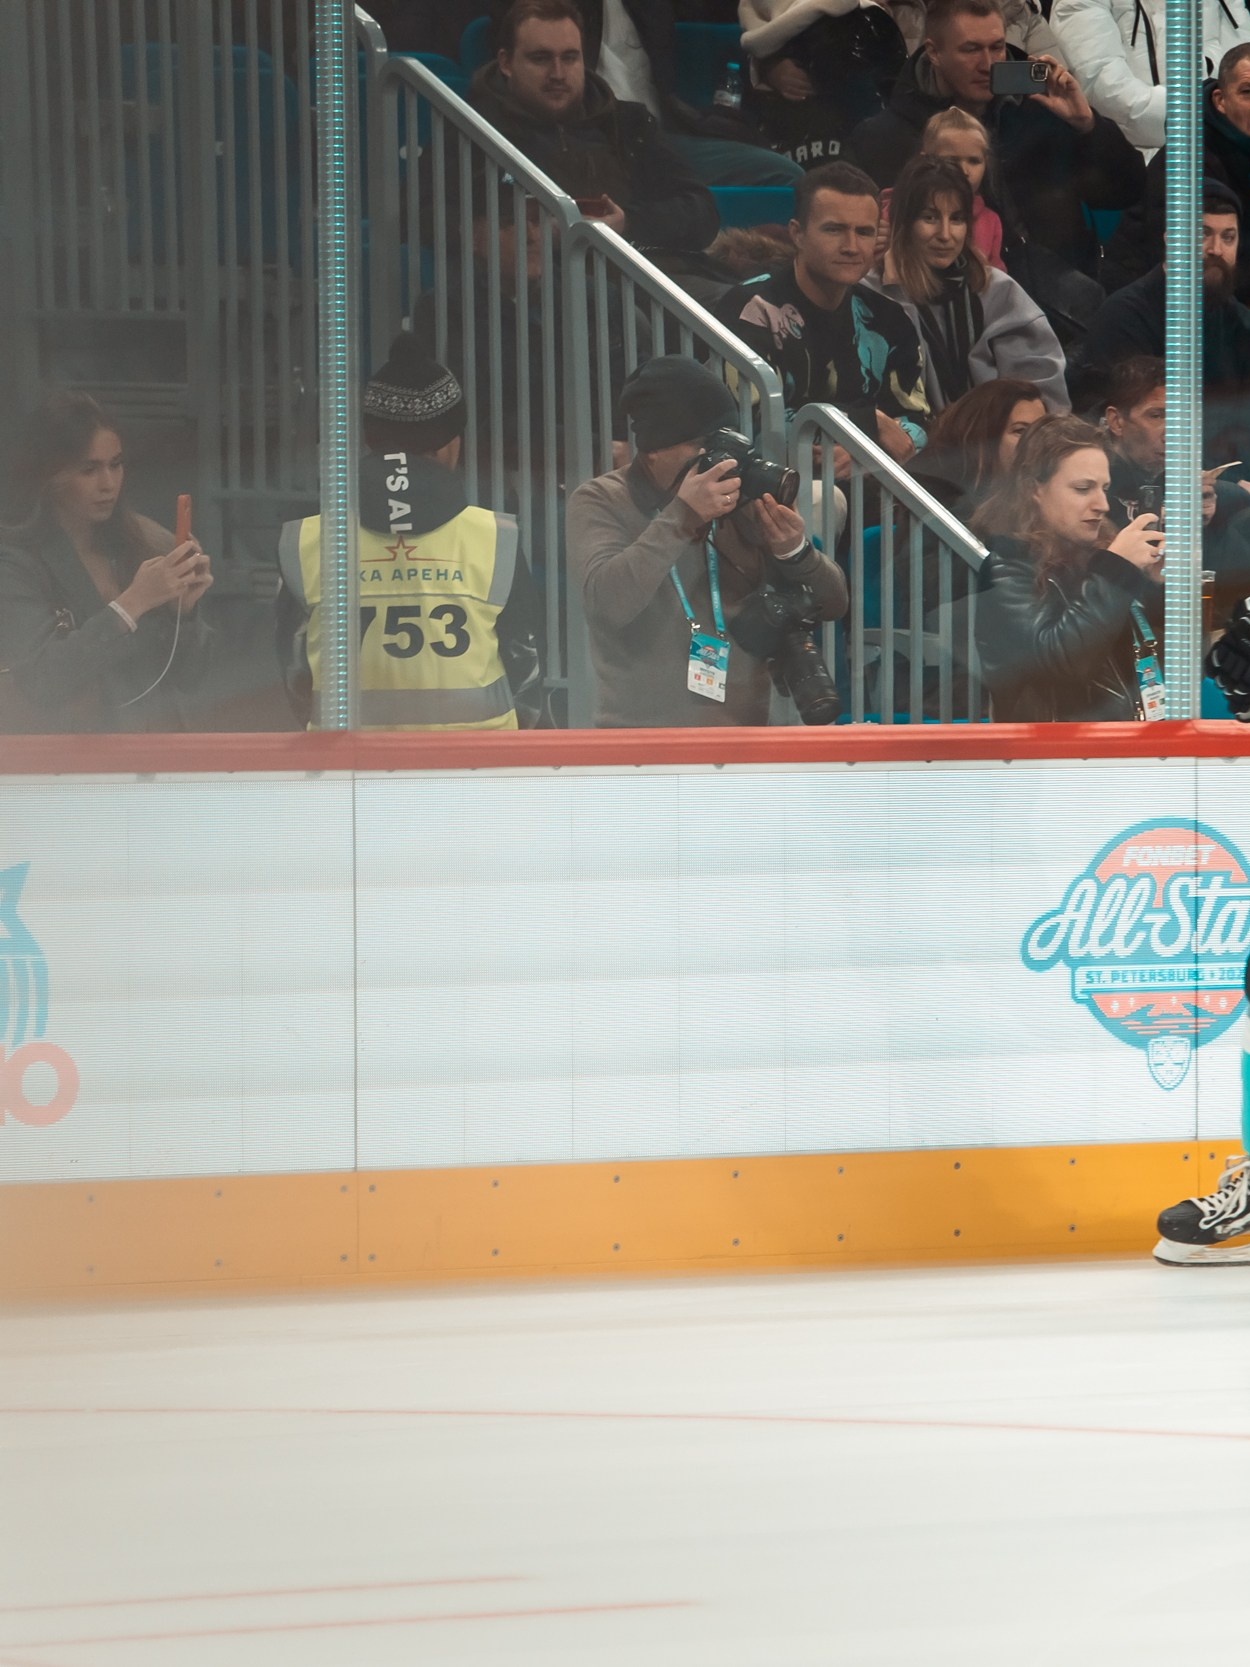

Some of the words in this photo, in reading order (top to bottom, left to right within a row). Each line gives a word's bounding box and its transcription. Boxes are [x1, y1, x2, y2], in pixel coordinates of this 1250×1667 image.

[391, 568, 464, 582] АРЕНА
[1122, 844, 1216, 867] FONBET
[1111, 967, 1205, 983] PETERSBURG
